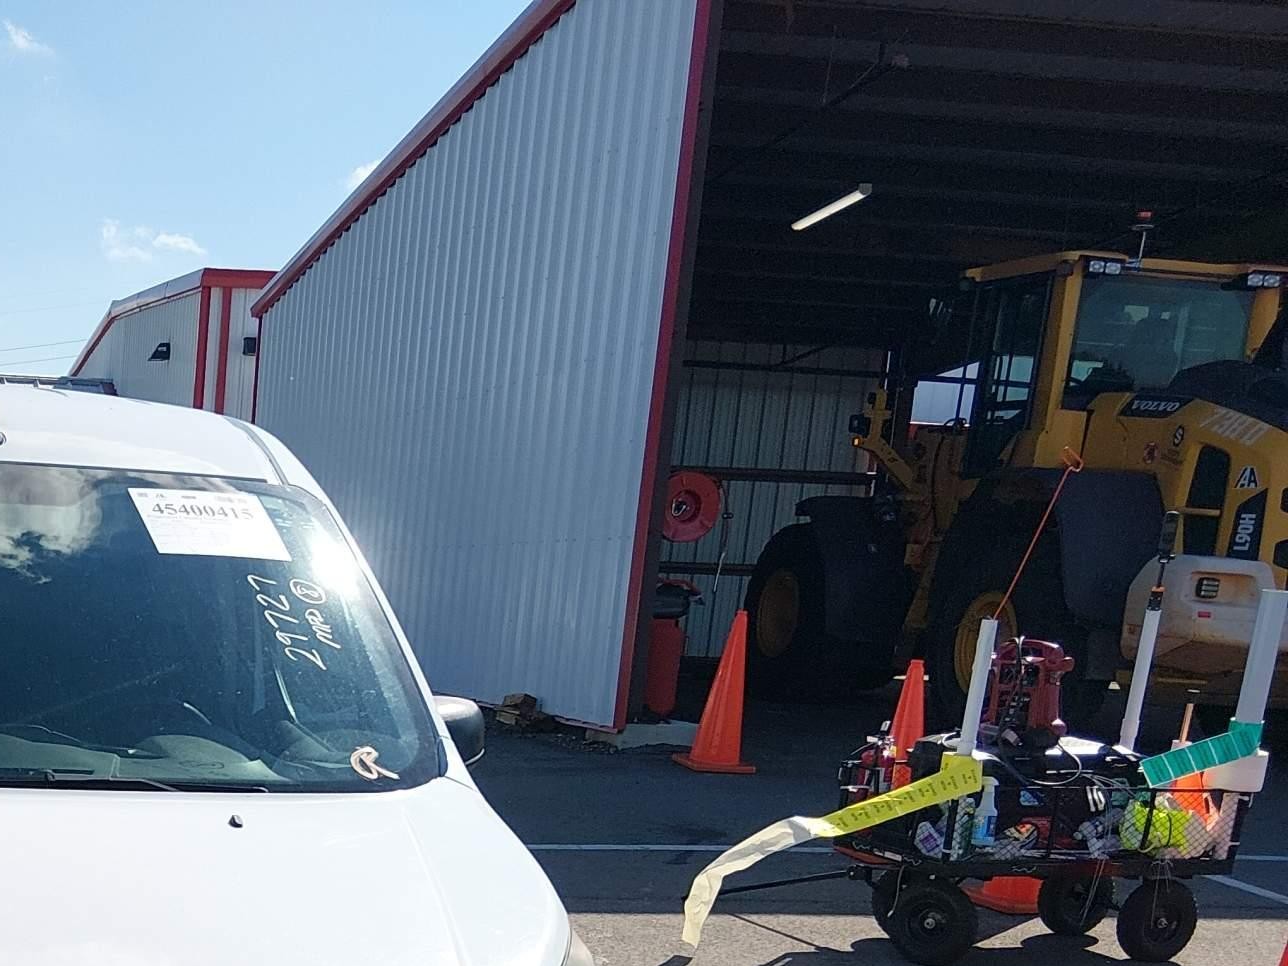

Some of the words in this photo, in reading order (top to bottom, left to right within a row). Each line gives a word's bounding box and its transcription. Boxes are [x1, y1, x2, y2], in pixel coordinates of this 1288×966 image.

[1130, 400, 1181, 412] VOLVO
[152, 502, 254, 520] 45400415
[1233, 513, 1257, 551] L90H
